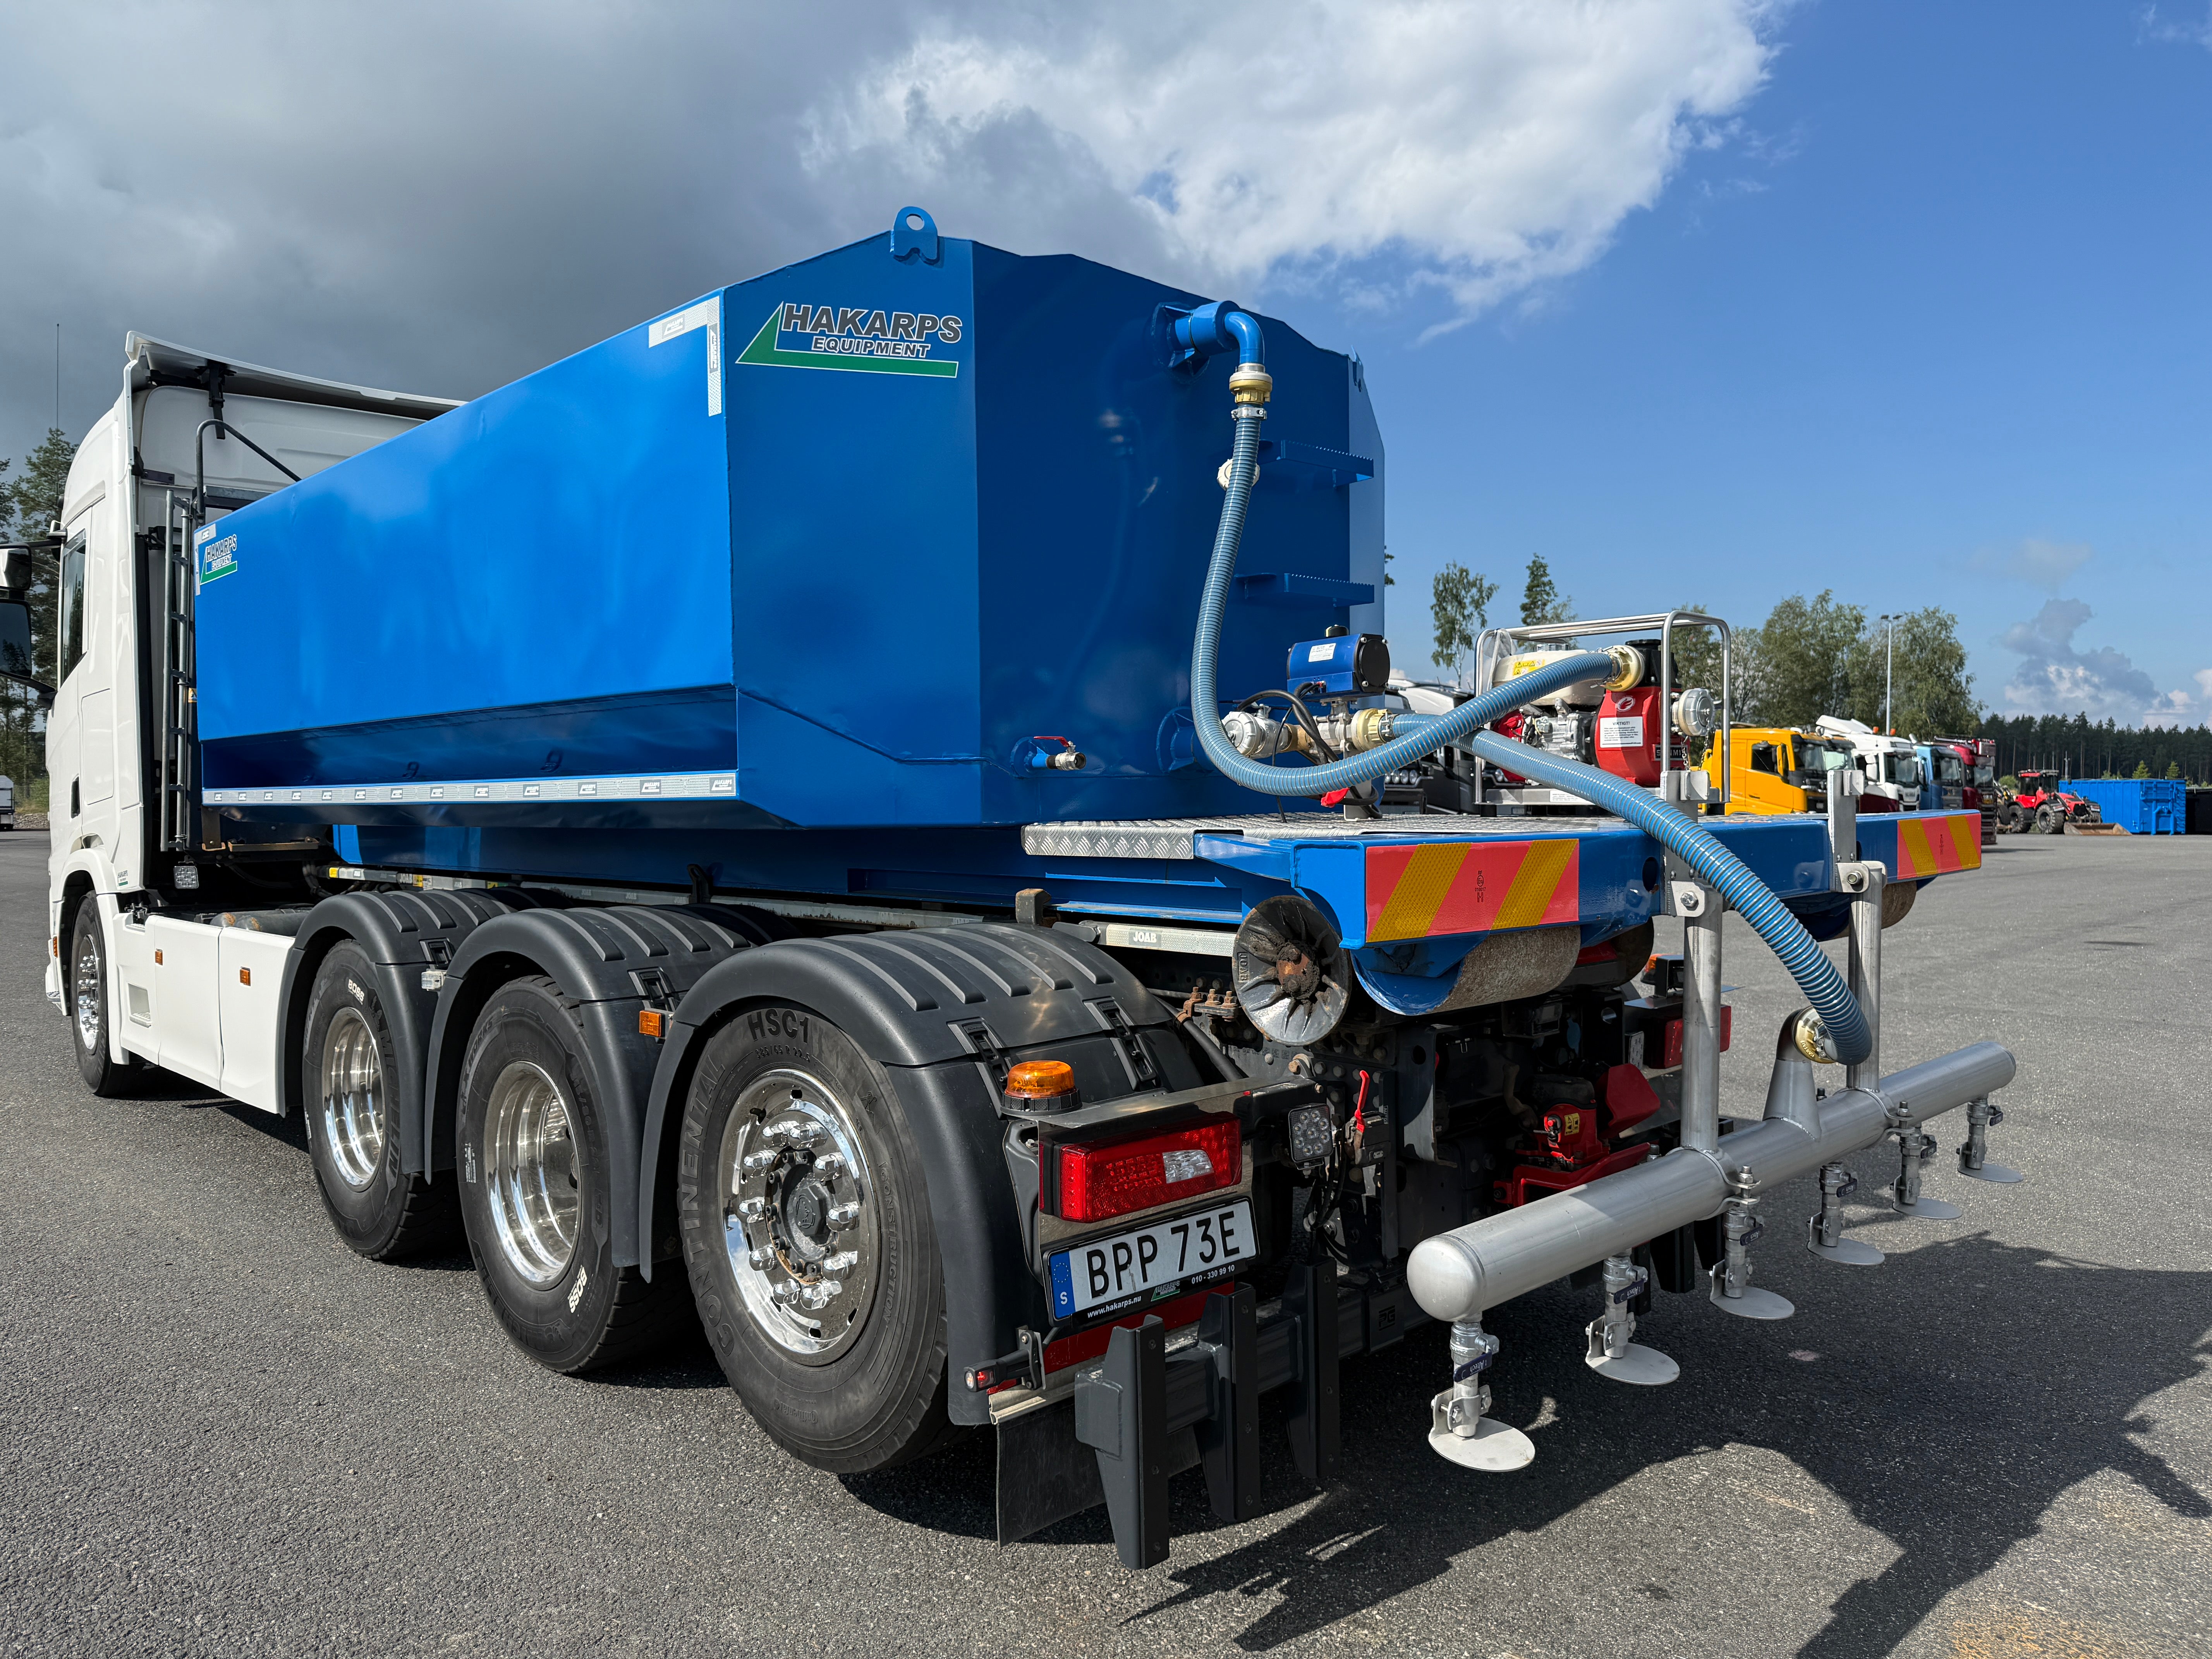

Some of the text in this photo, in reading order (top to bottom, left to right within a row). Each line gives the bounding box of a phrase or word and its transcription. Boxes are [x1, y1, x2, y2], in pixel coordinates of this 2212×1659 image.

[781, 303, 962, 343] HAKARPS
[811, 336, 930, 358] EQUIPMENT
[206, 534, 237, 562] HAKARPS
[211, 553, 232, 570] EQUIPMENT
[399, 873, 412, 884] JOAB
[1133, 931, 1157, 943] JOAB
[1240, 953, 1249, 981] JOAB
[348, 979, 364, 1002] BOSS
[747, 1008, 810, 1044] HSC1
[681, 1054, 734, 1356] CONTINENTAL
[880, 1167, 898, 1323] CONSTRUCTION
[1086, 1211, 1240, 1298] BPP 73E
[1191, 1276, 1202, 1285] 010
[1207, 1271, 1218, 1280] 330
[1219, 1267, 1228, 1276] 99
[1228, 1264, 1235, 1273] 10
[569, 1266, 587, 1314] BOSS
[1060, 1291, 1068, 1305] S
[1087, 1295, 1141, 1318] www.hakarps.nu
[1470, 1360, 1484, 1373] Altech
